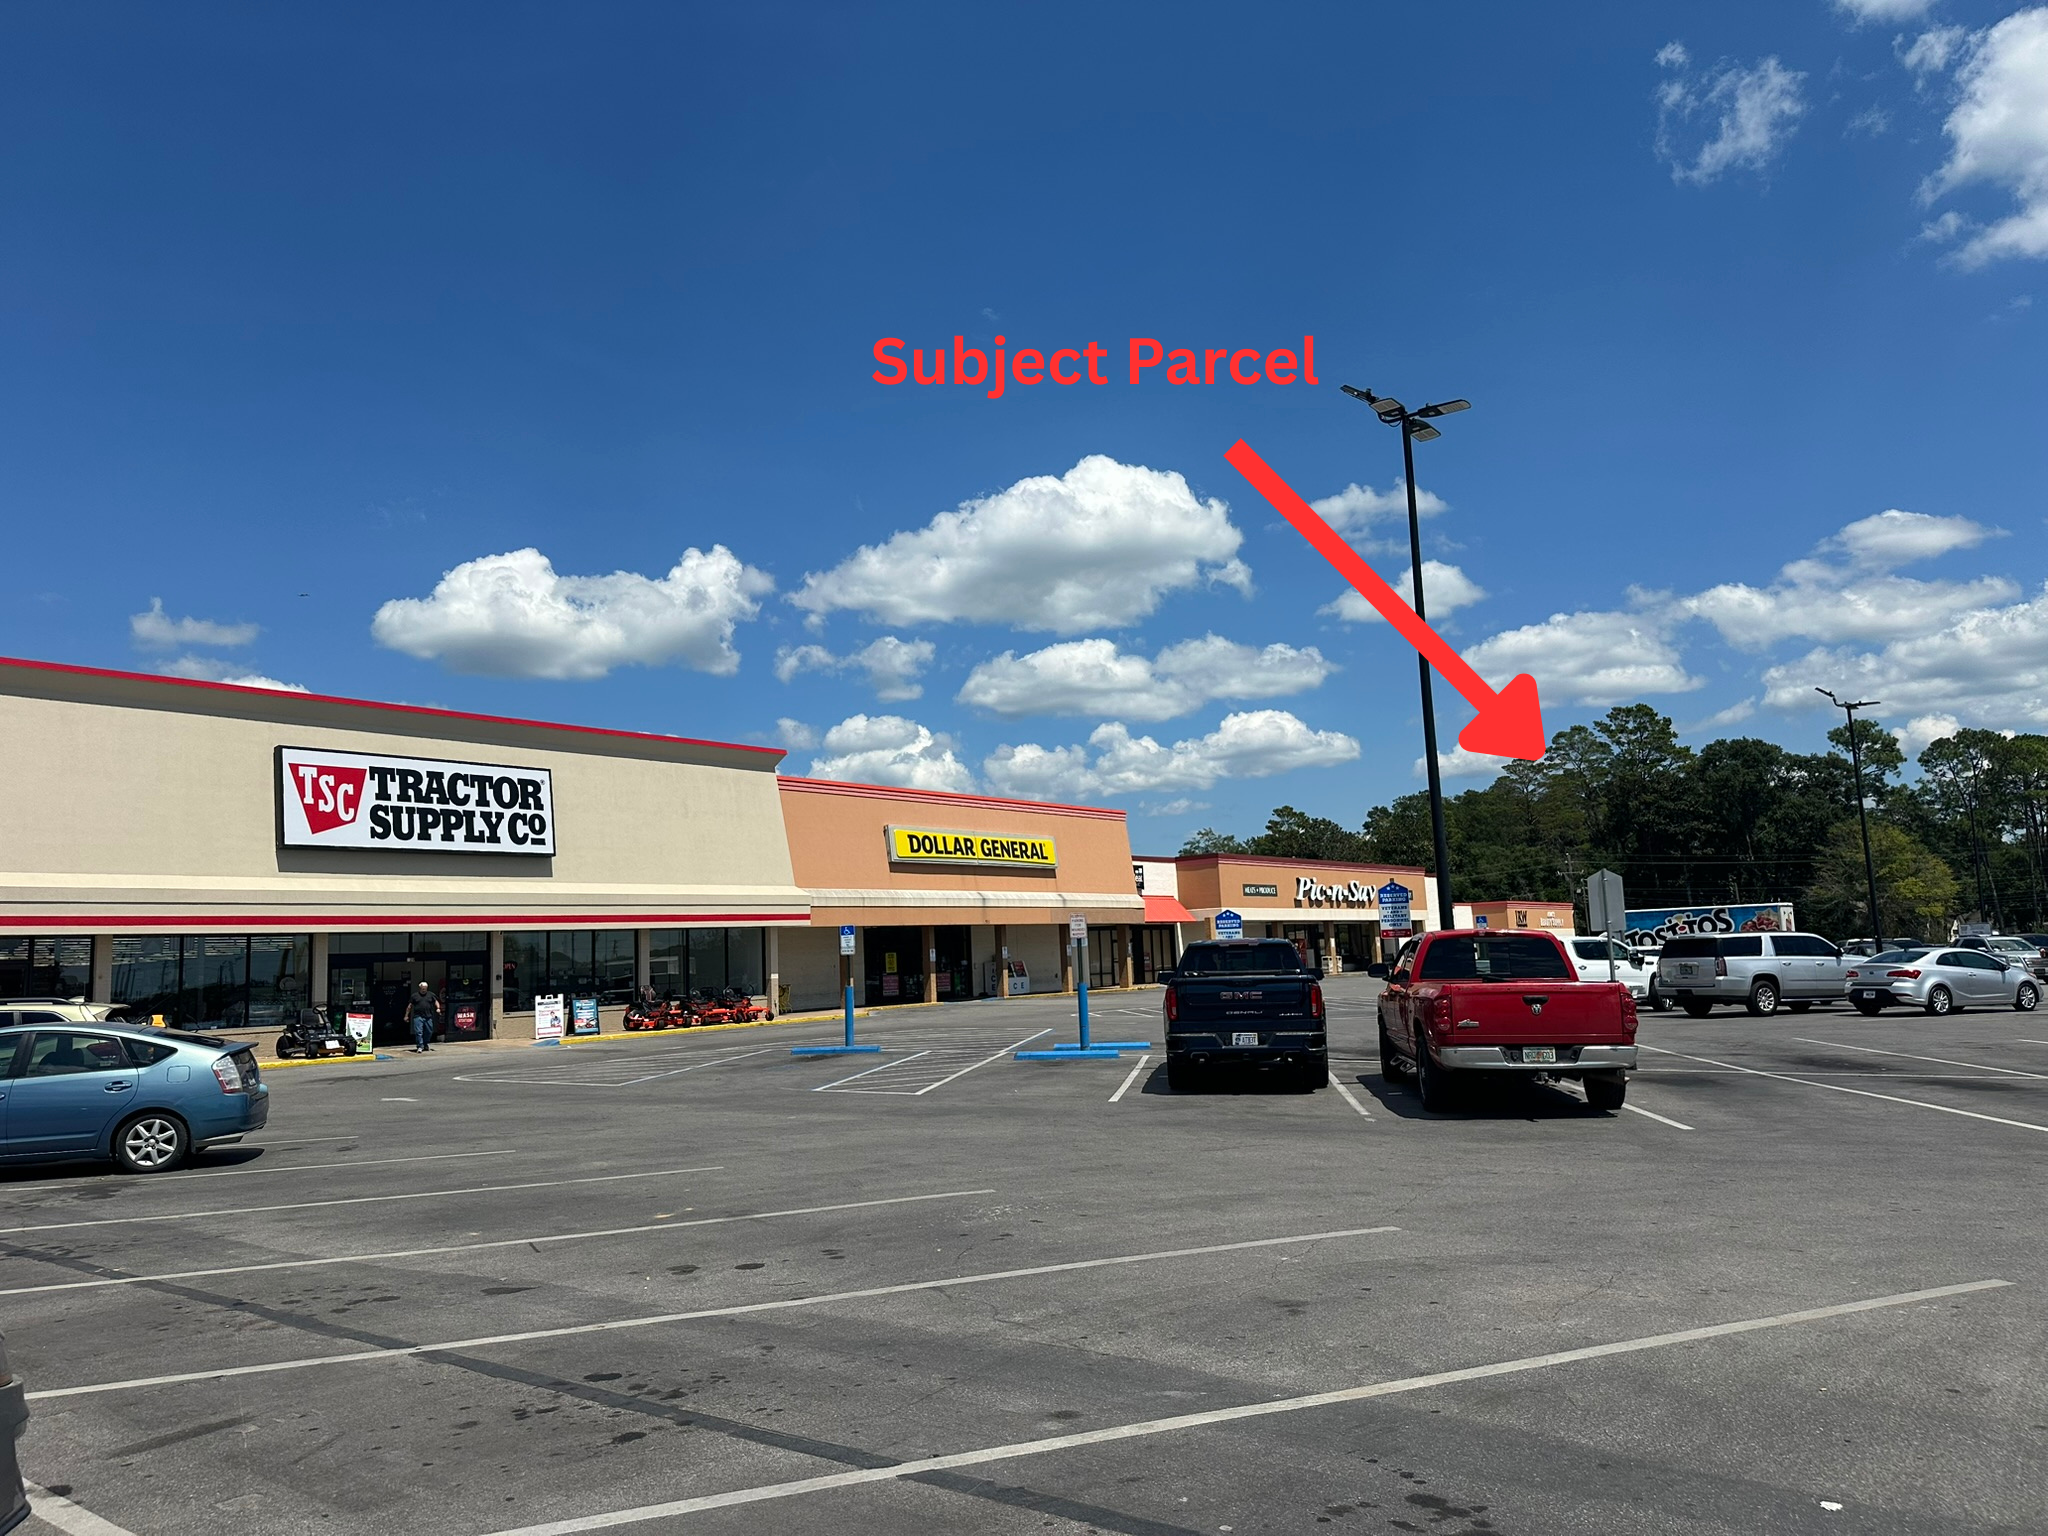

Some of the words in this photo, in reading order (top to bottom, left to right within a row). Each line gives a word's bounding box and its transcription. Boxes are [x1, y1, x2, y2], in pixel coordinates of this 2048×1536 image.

[298, 766, 354, 822] TSC
[369, 766, 544, 811] TRACTOR
[369, 804, 504, 844] SUPPLY
[907, 834, 975, 856] DOLLAR
[980, 839, 1048, 860] GENERAL
[1220, 991, 1263, 999] GMC
